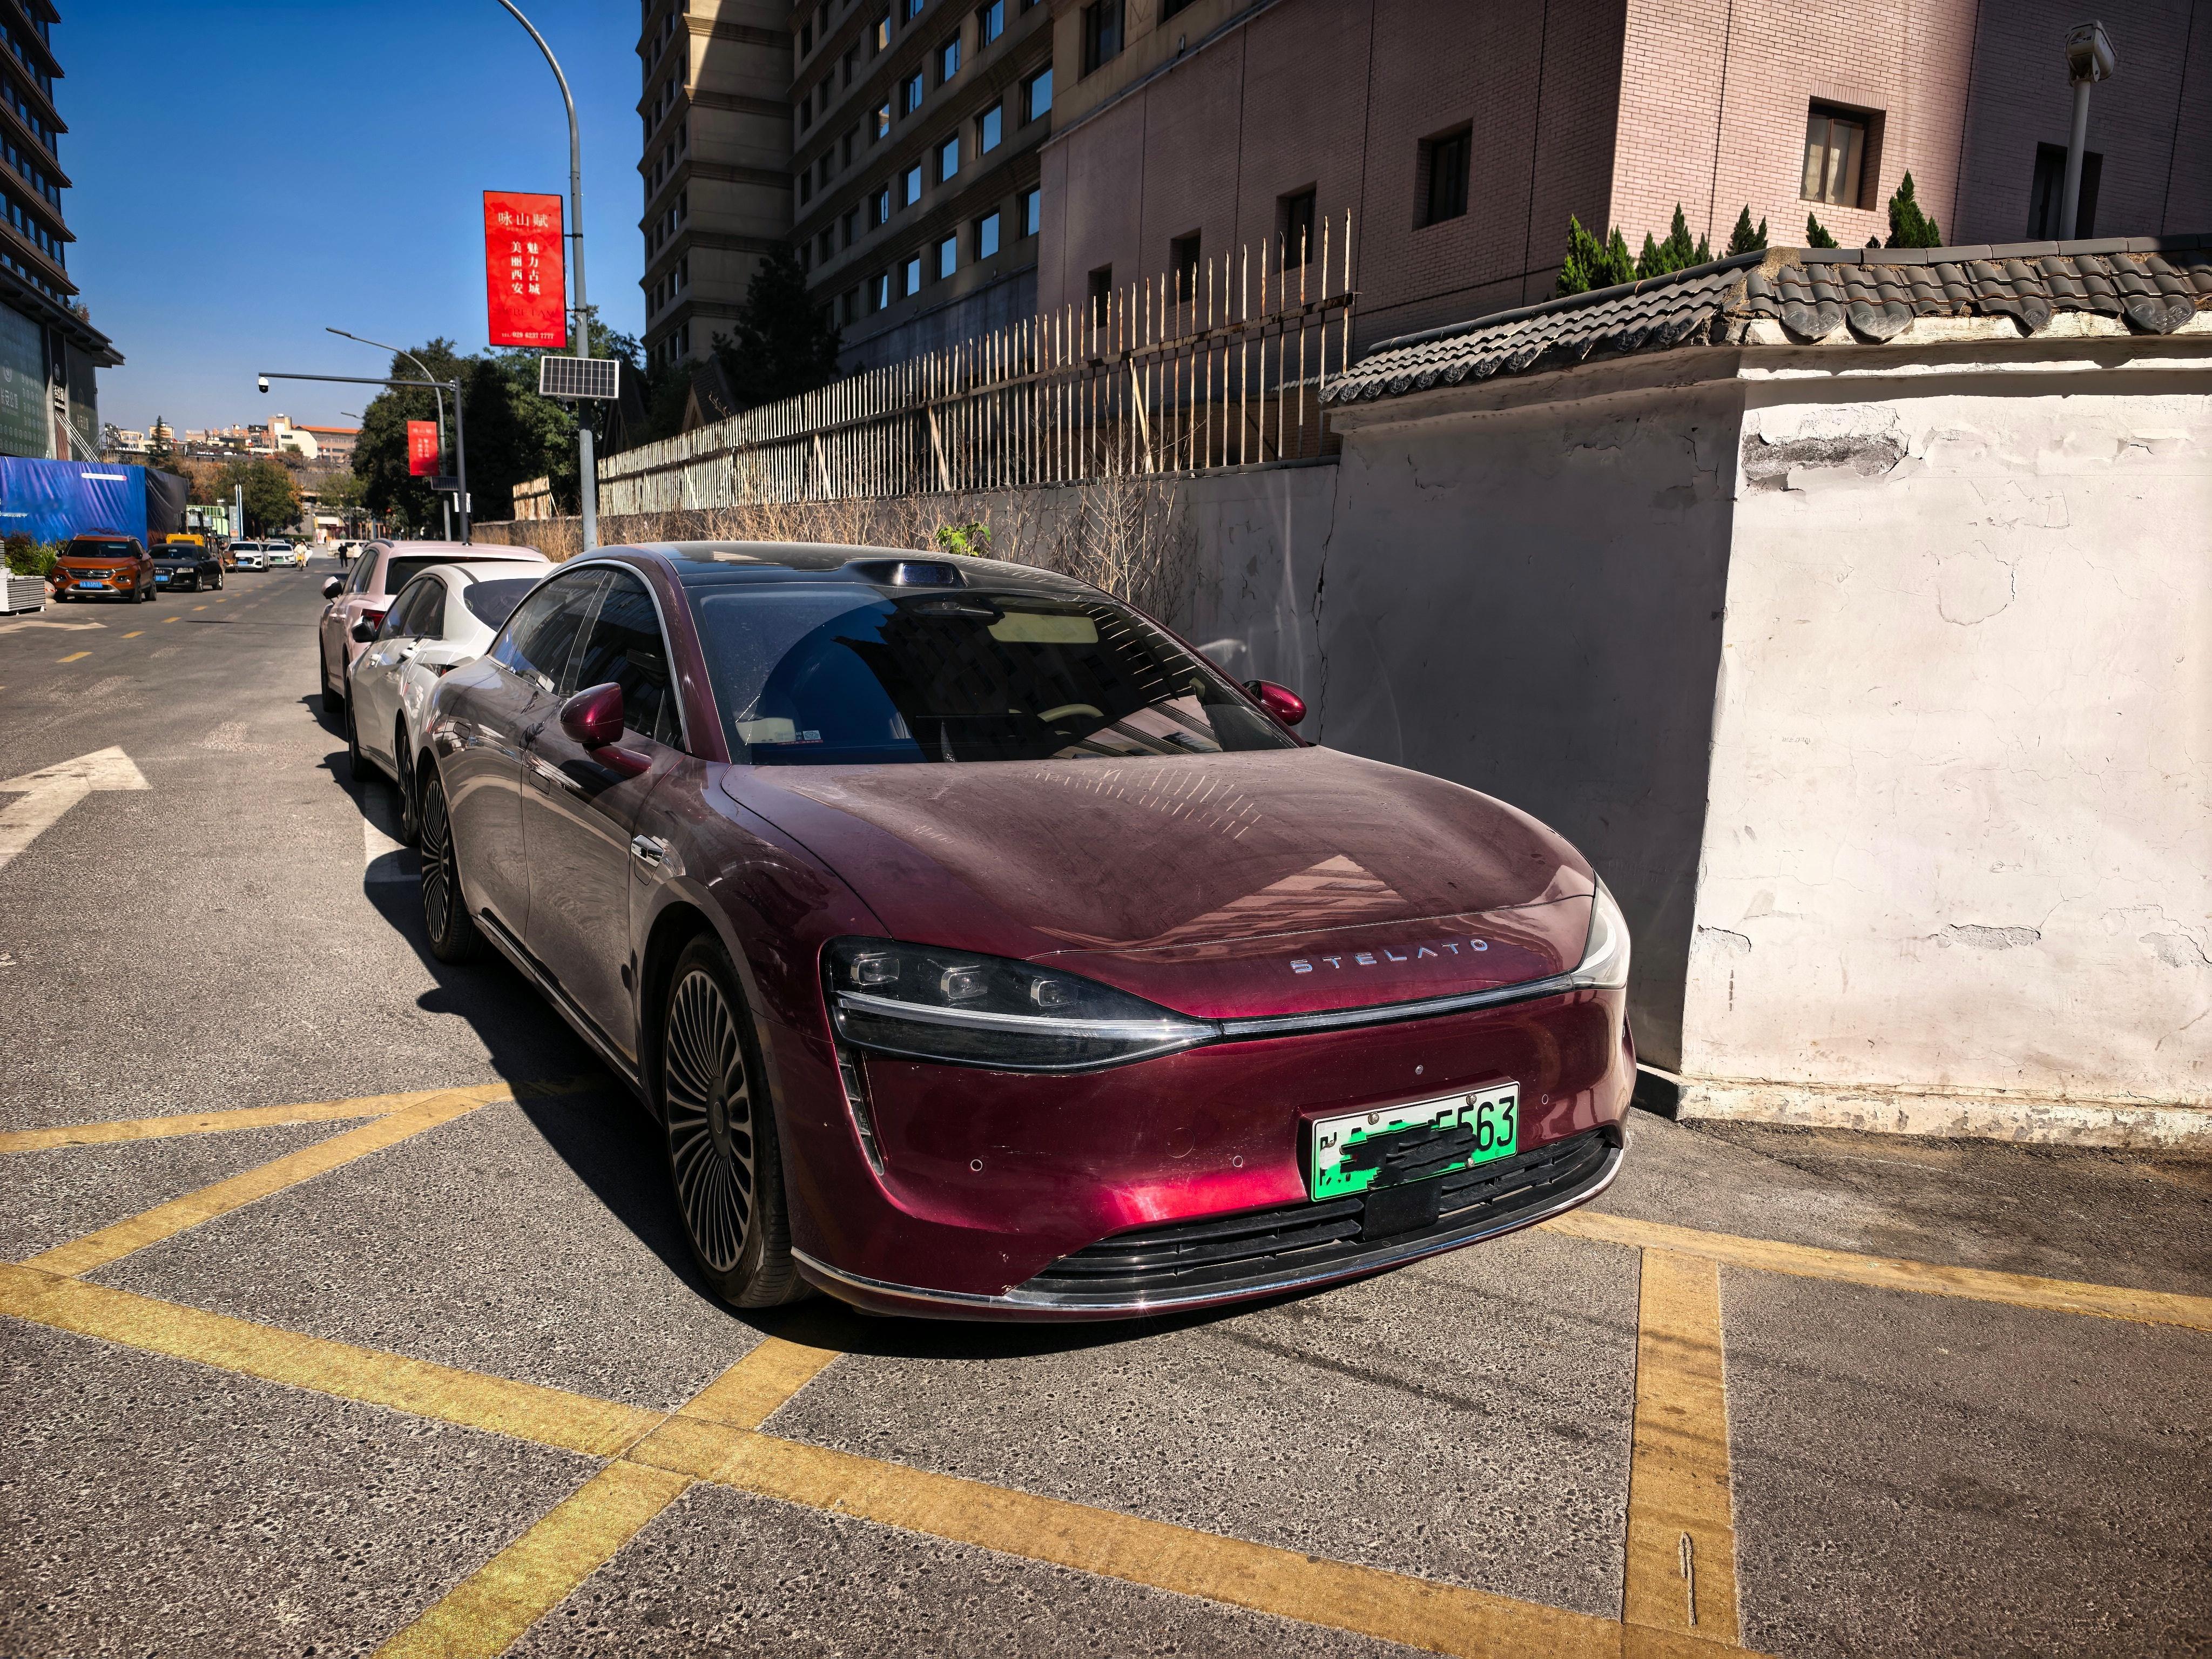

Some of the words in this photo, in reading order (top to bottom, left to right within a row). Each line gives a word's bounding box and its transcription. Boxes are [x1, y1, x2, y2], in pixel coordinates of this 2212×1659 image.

[497, 211, 549, 227] 咏山赋
[511, 241, 523, 294] 美丽西安
[527, 242, 541, 295] 魅力古城
[1290, 938, 1488, 973] STELATO
